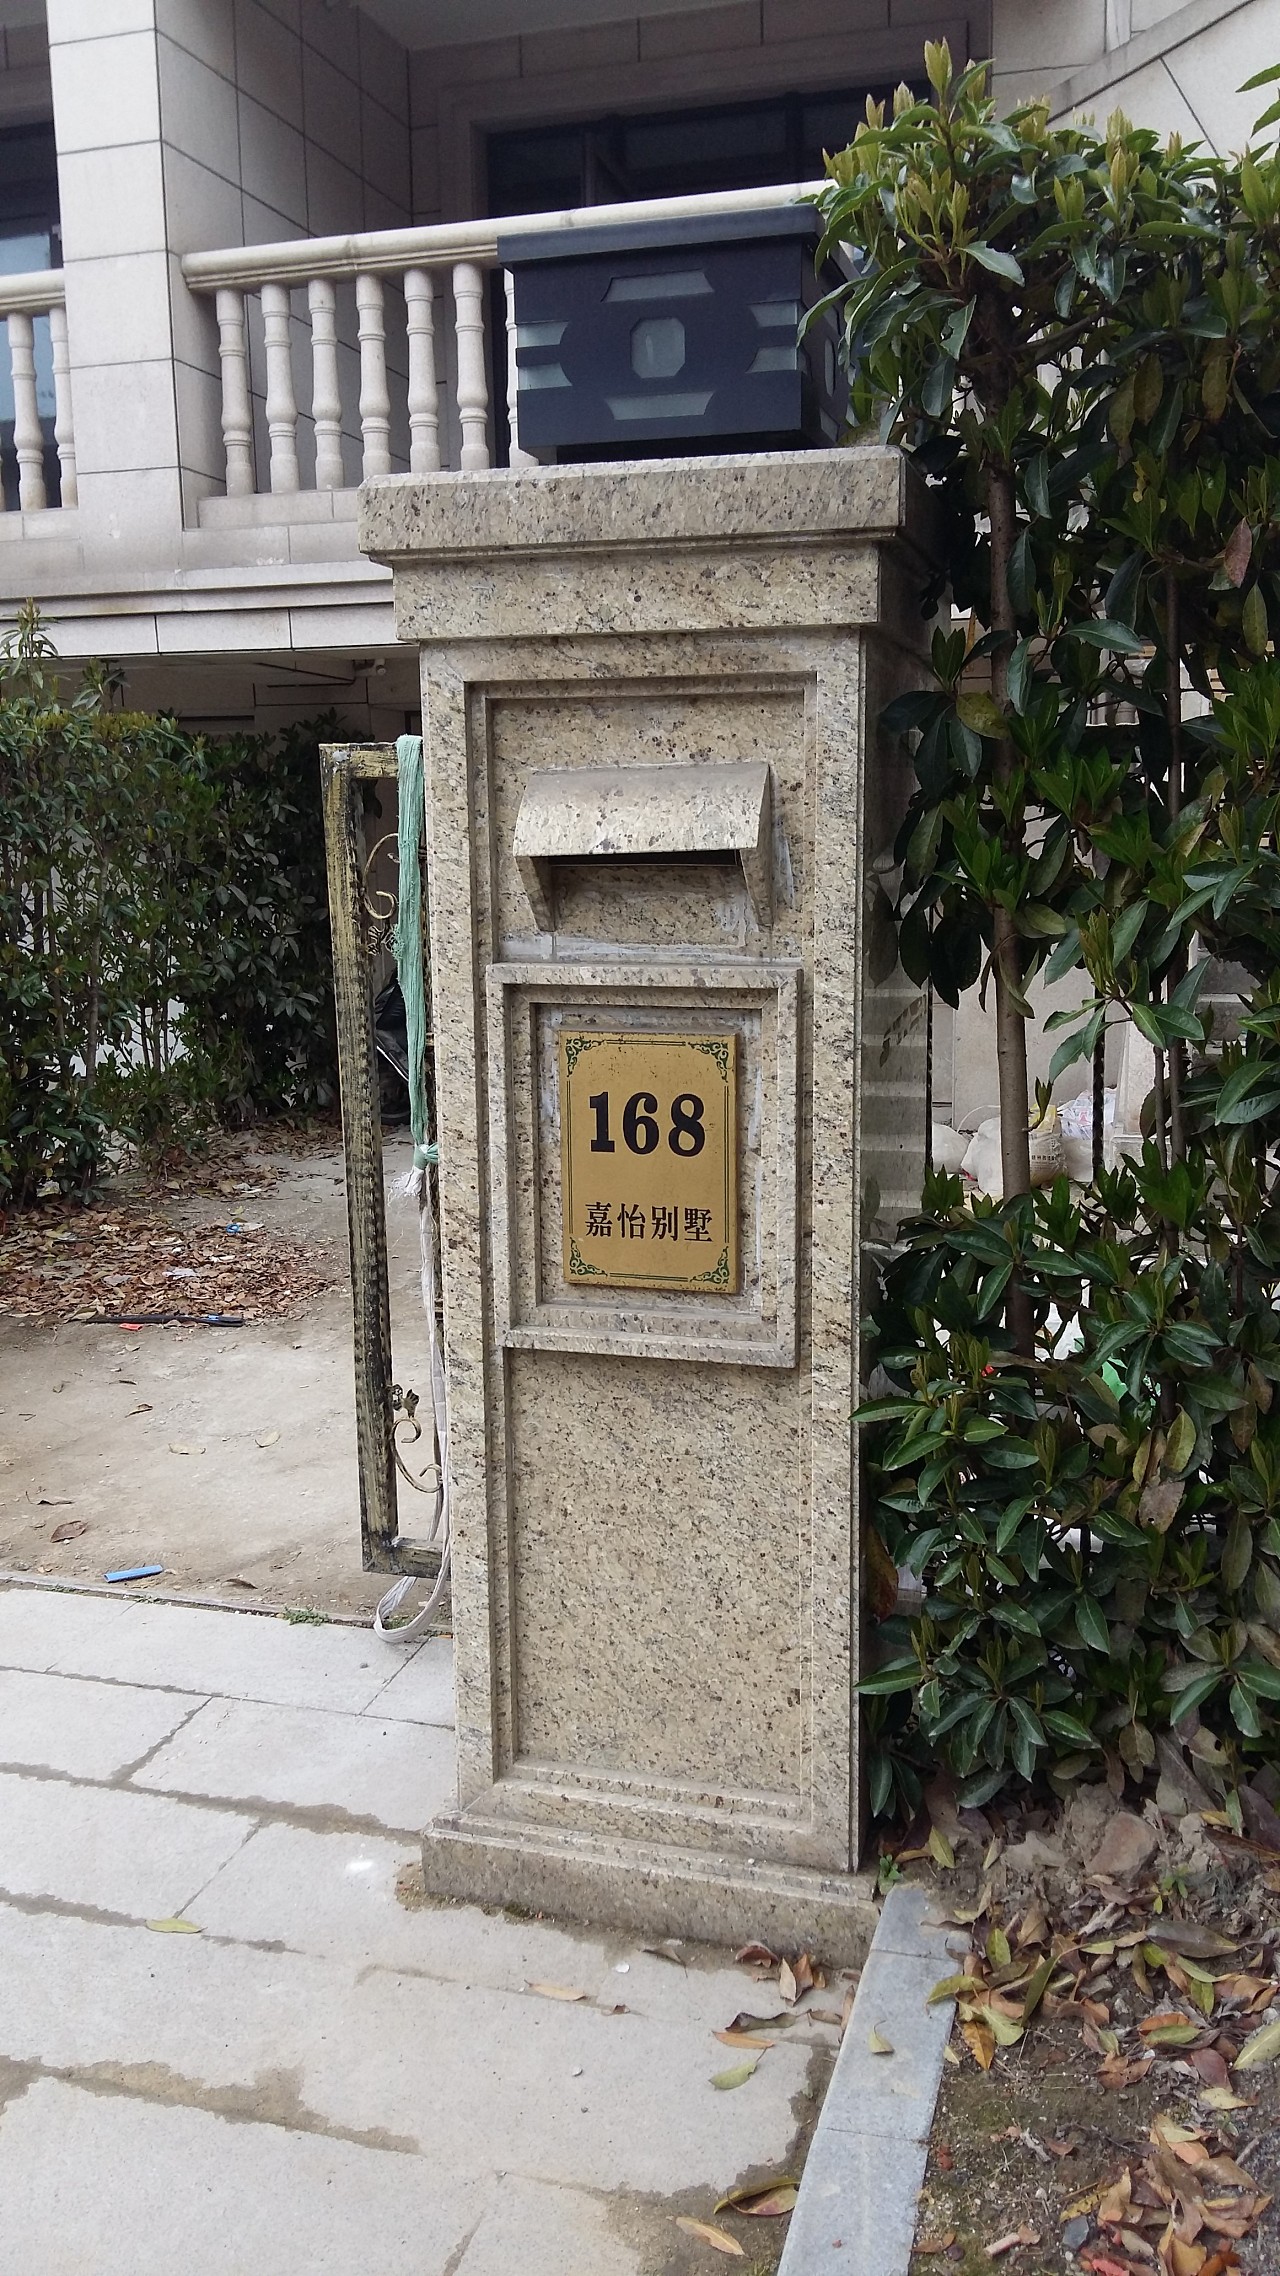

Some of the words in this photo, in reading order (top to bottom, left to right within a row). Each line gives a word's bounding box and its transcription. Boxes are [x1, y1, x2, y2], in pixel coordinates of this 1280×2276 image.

[589, 1091, 706, 1157] 168
[584, 1201, 713, 1242] 嘉怡别墅
